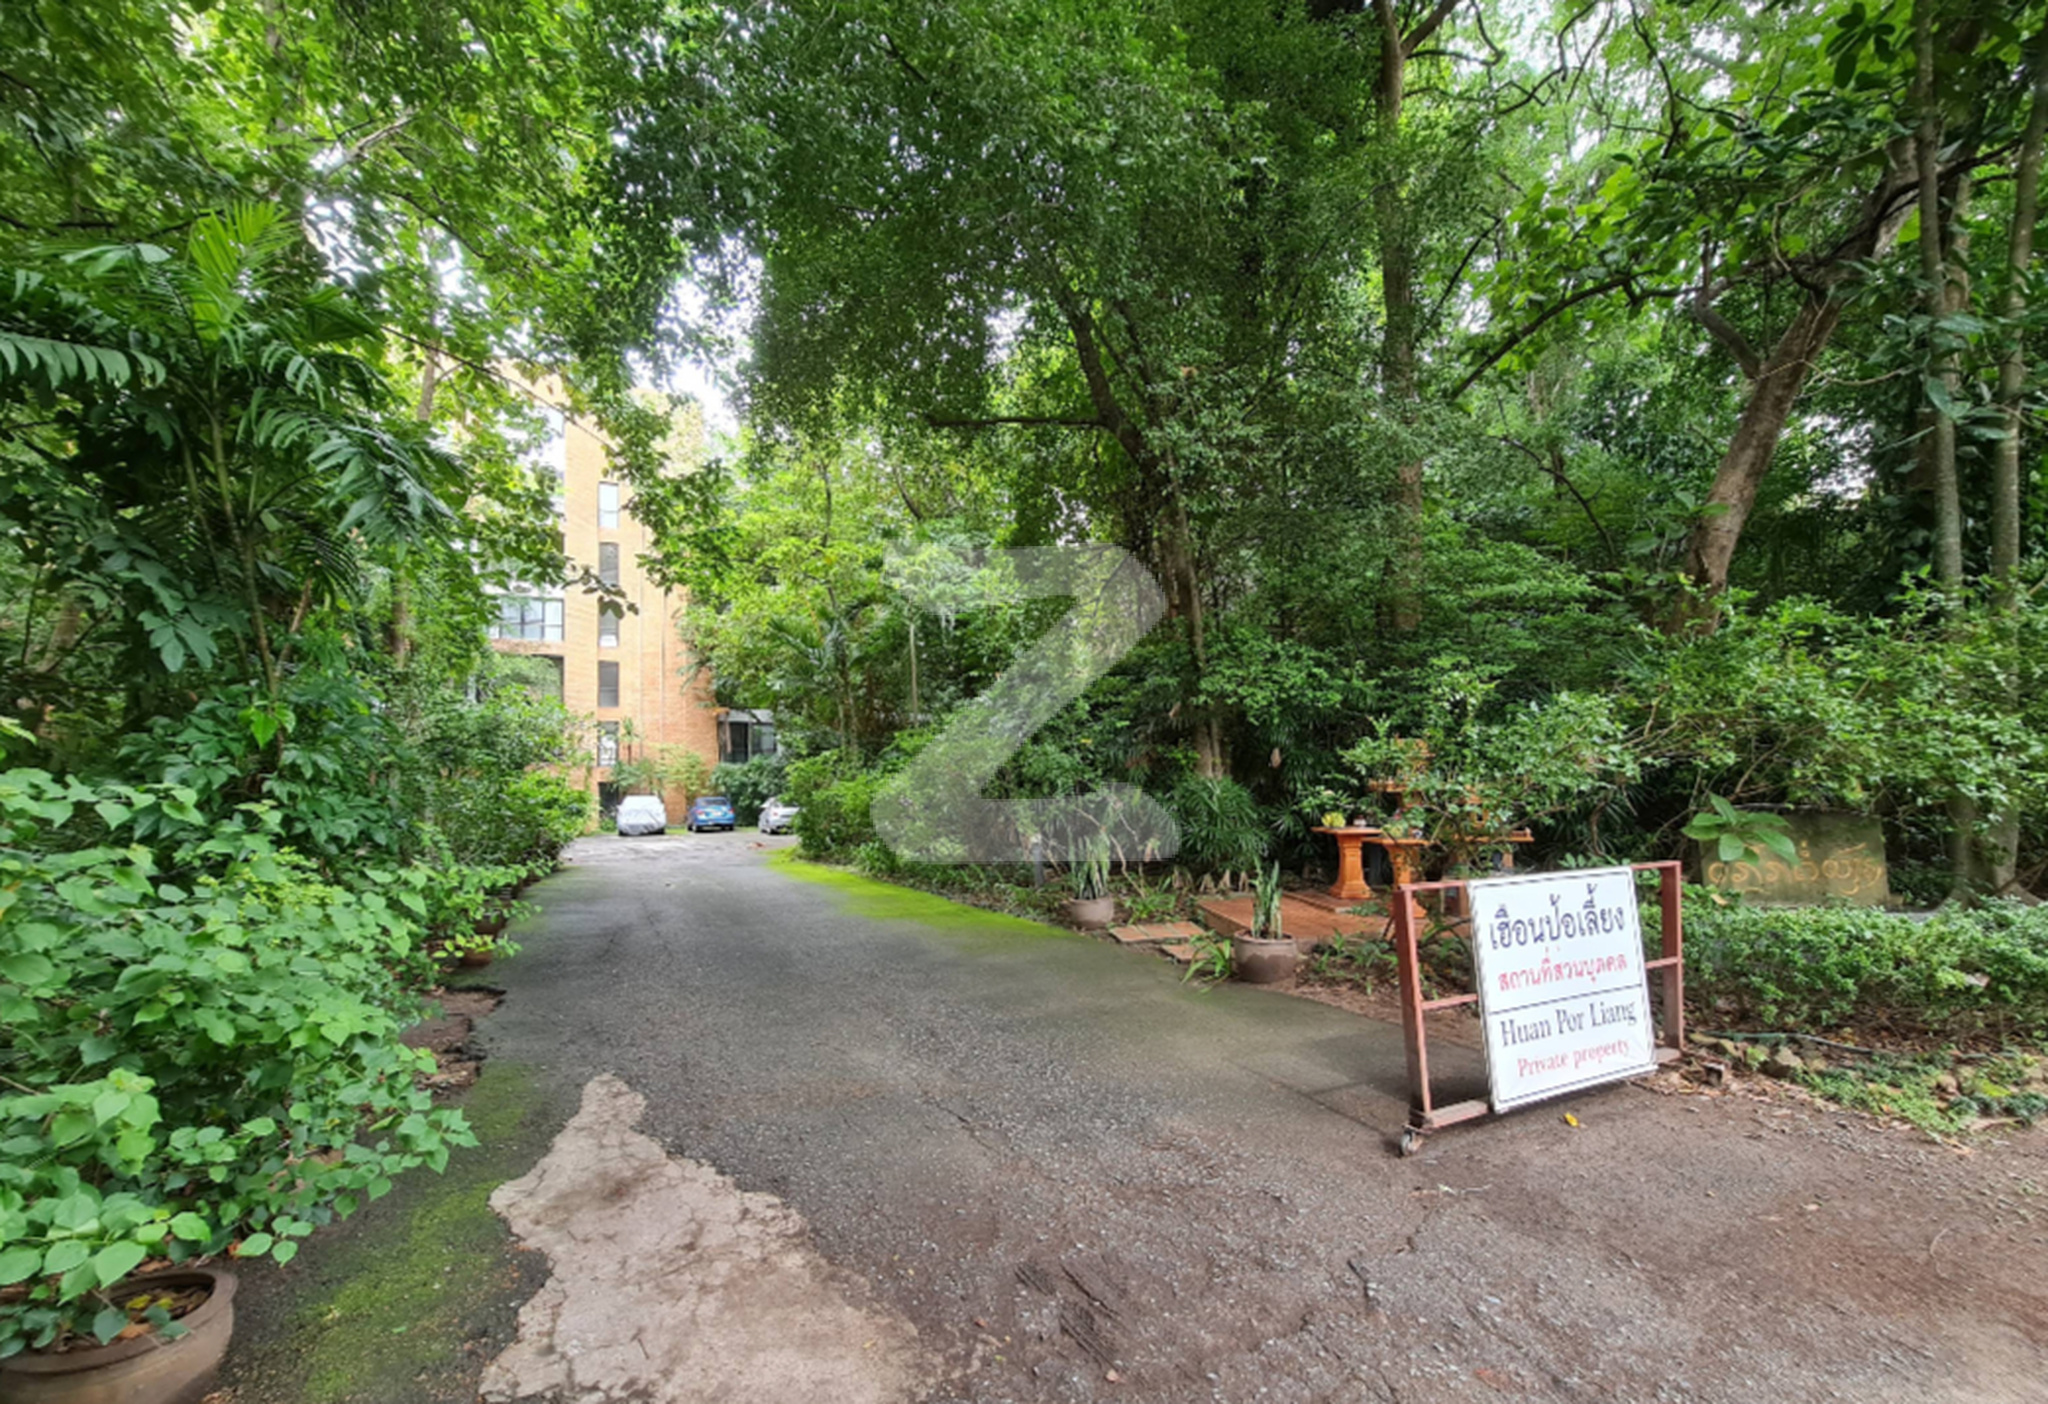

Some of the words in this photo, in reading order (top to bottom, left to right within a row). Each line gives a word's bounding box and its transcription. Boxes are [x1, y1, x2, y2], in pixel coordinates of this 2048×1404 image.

[1500, 1017, 1553, 1047] Huan
[1555, 1008, 1585, 1035] Por
[1589, 1001, 1638, 1026] Liang
[1517, 1052, 1570, 1078] Private
[1573, 1039, 1630, 1070] property
